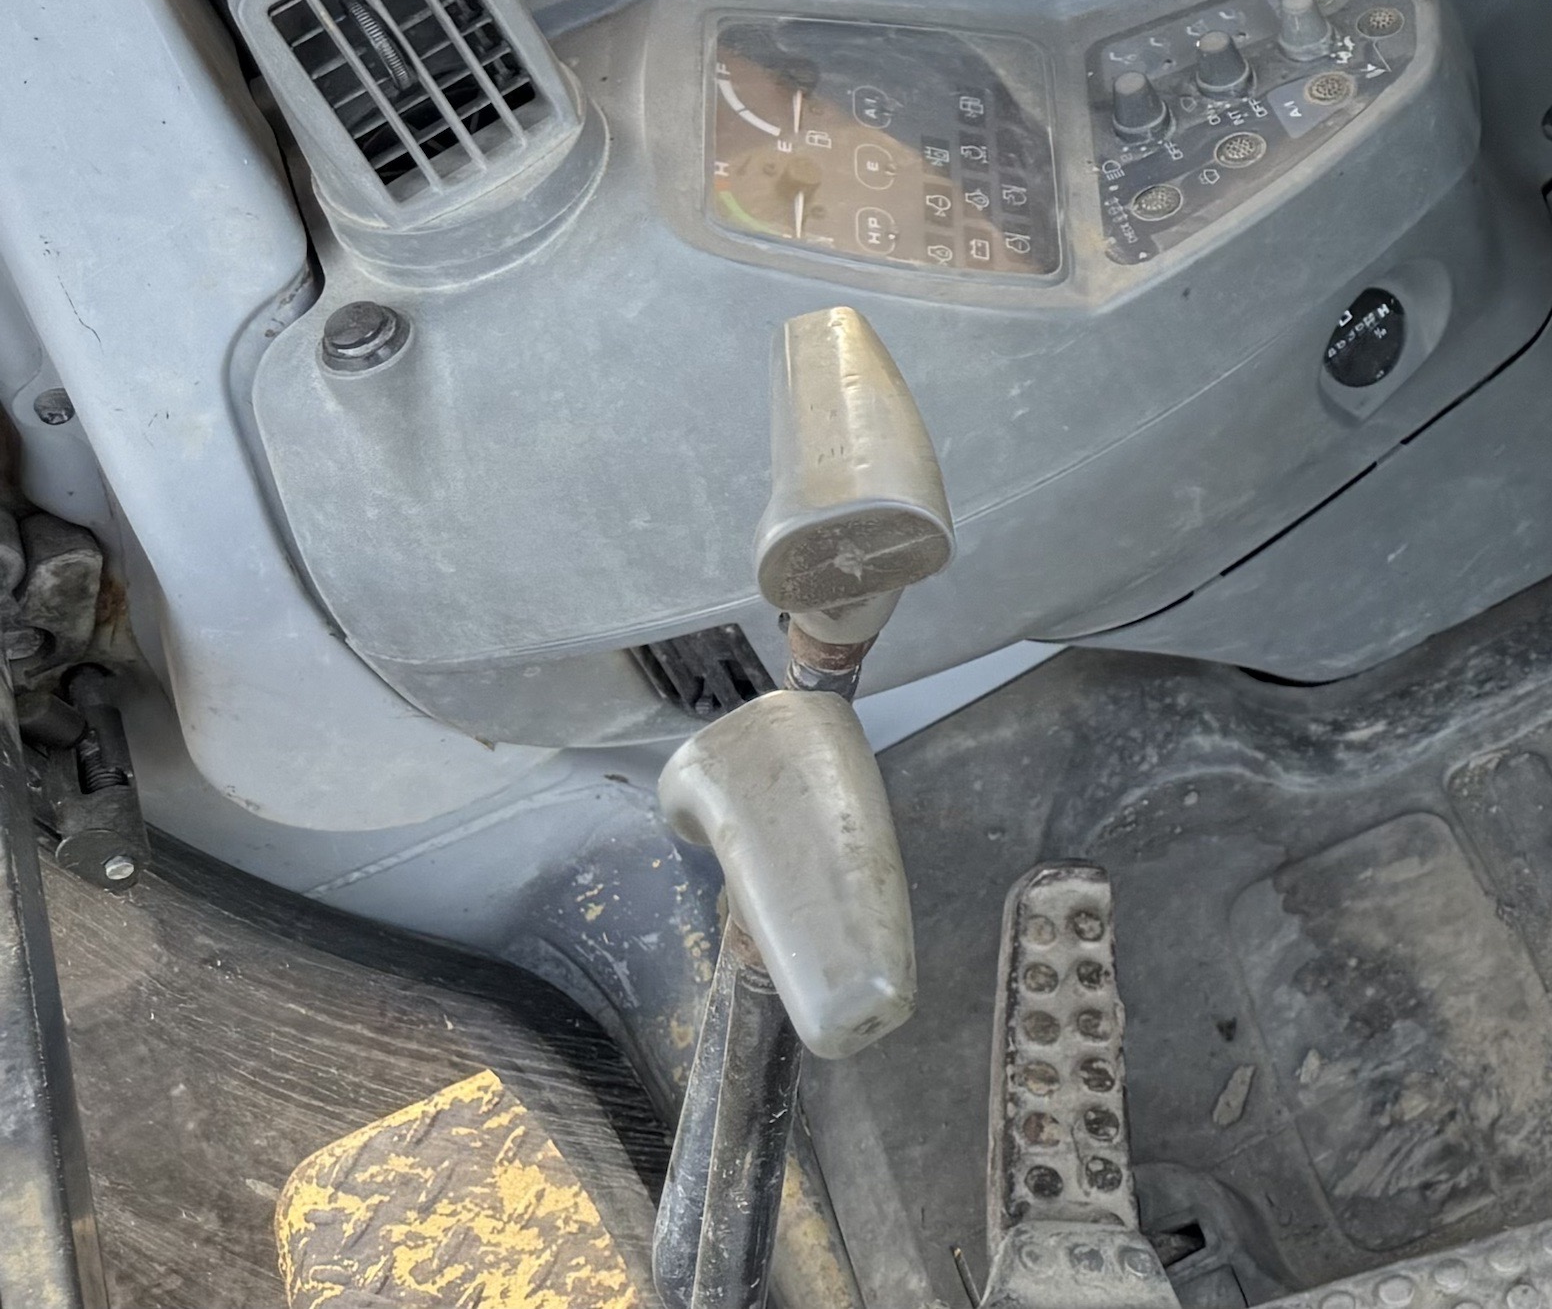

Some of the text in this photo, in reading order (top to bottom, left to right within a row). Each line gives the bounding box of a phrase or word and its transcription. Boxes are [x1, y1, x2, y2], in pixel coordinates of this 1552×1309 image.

[717, 62, 730, 75] F
[1248, 98, 1268, 118] OFF
[777, 139, 792, 152] E
[1164, 141, 1183, 160] OFF
[714, 162, 729, 176] H
[867, 161, 879, 172] E
